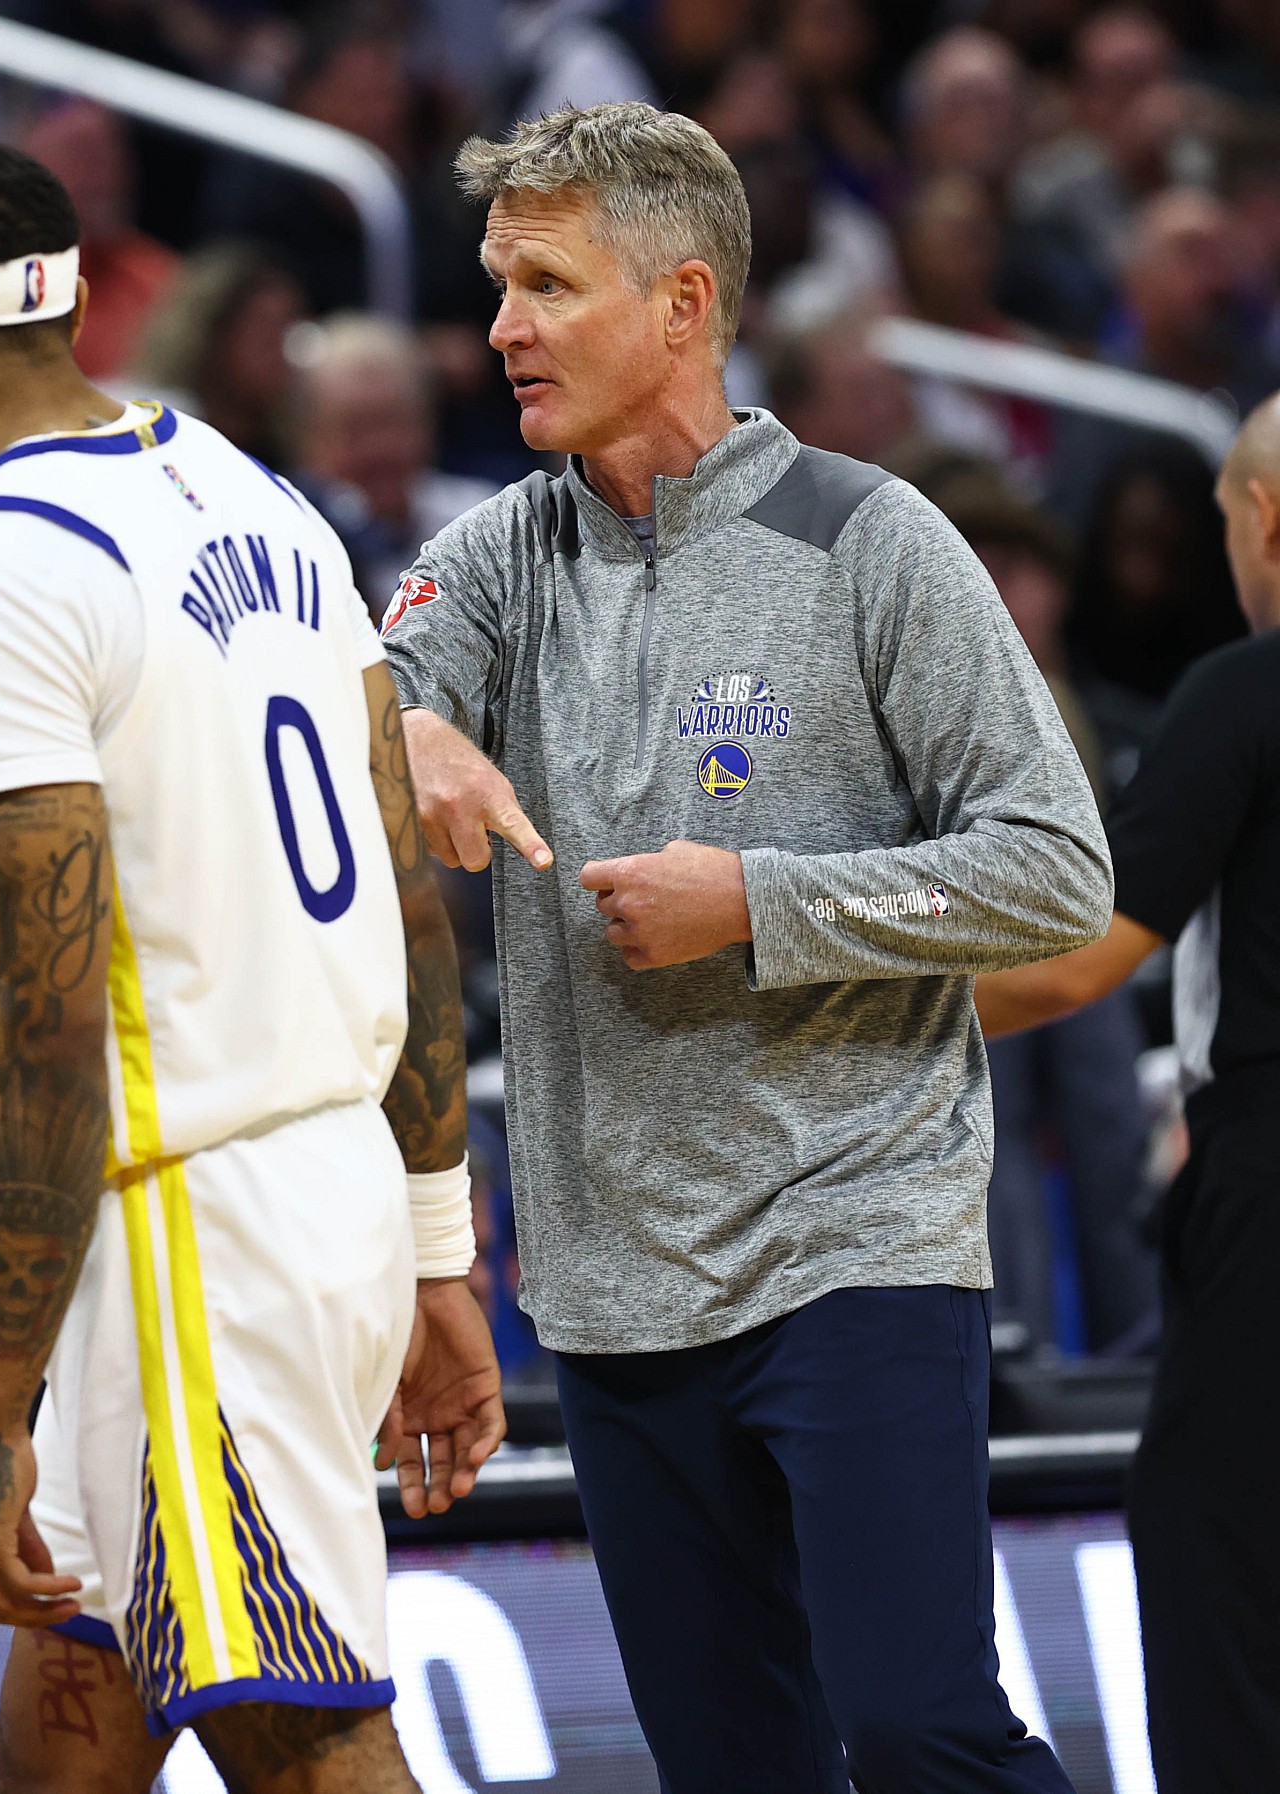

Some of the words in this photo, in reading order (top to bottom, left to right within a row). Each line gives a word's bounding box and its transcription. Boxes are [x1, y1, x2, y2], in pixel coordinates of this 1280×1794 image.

[181, 533, 281, 660] PAYTON
[677, 703, 792, 738] WARRIORS
[715, 674, 751, 703] LOS
[264, 695, 357, 923] 0
